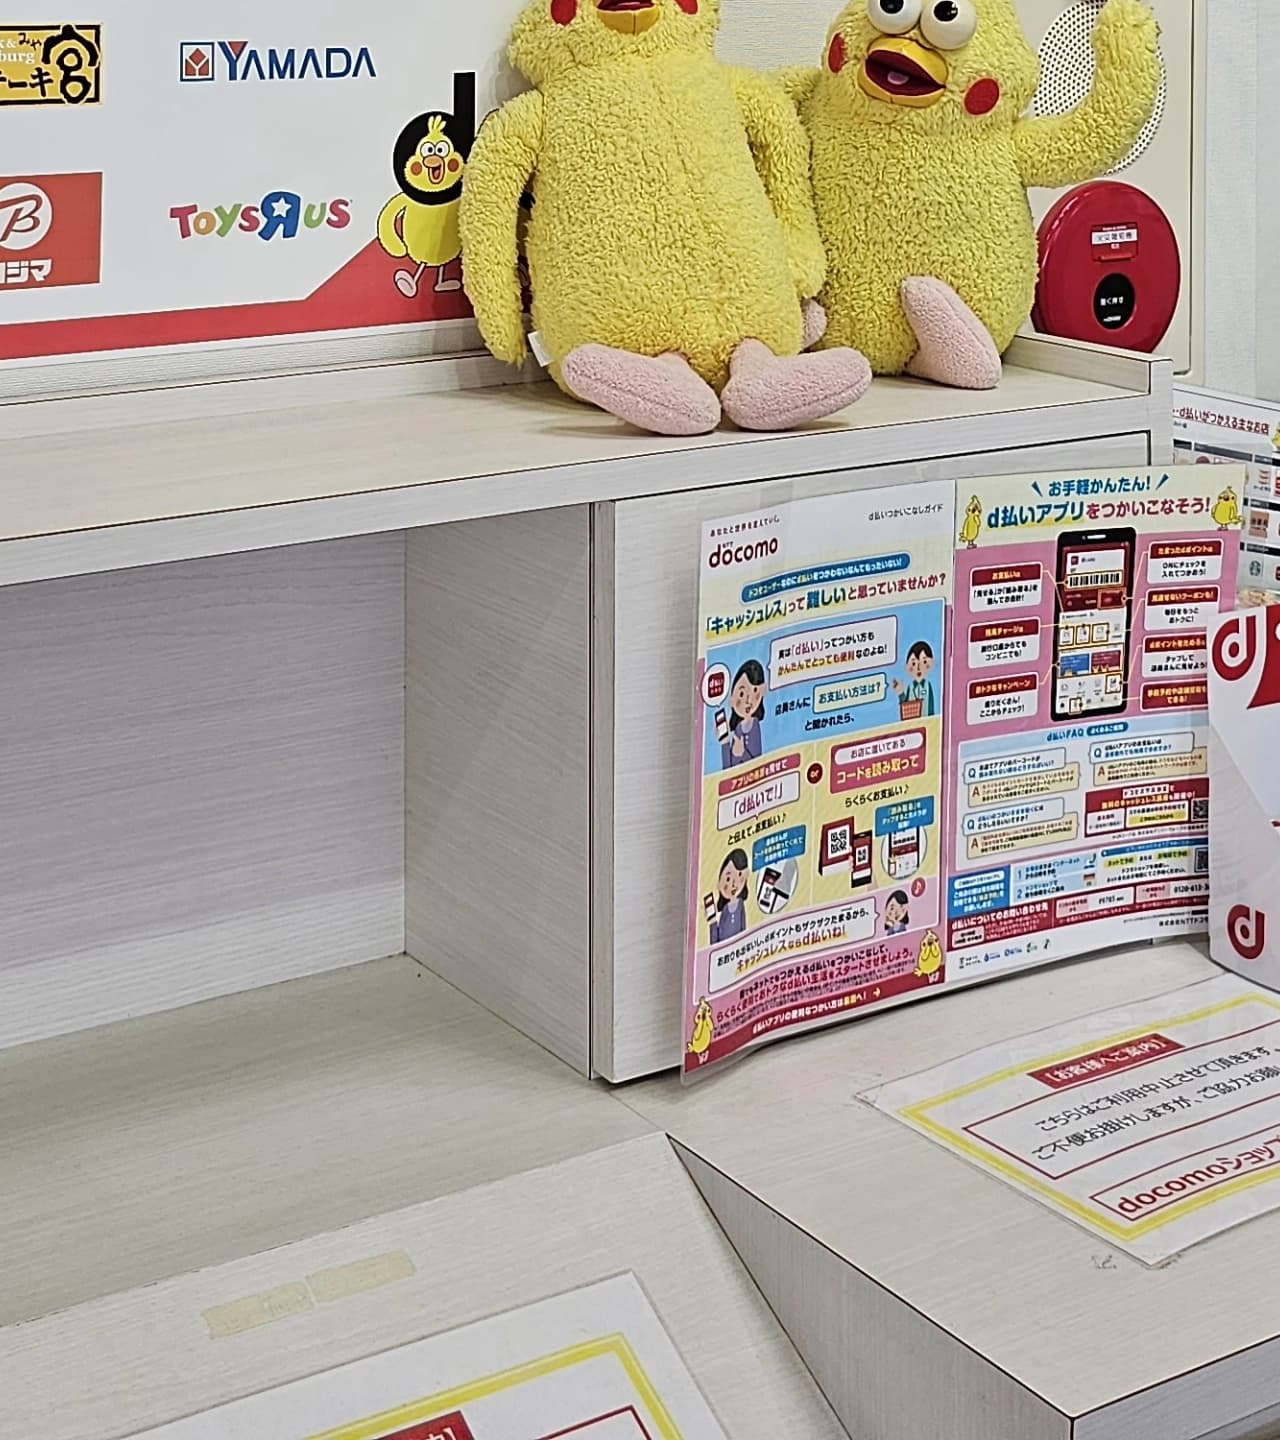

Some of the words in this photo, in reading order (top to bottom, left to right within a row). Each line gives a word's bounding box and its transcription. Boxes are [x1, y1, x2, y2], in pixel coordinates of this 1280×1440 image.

[219, 41, 377, 80] YAMADA
[986, 497, 1212, 530] d払いアプリをつかいこなそう!
[708, 536, 779, 569] docomo
